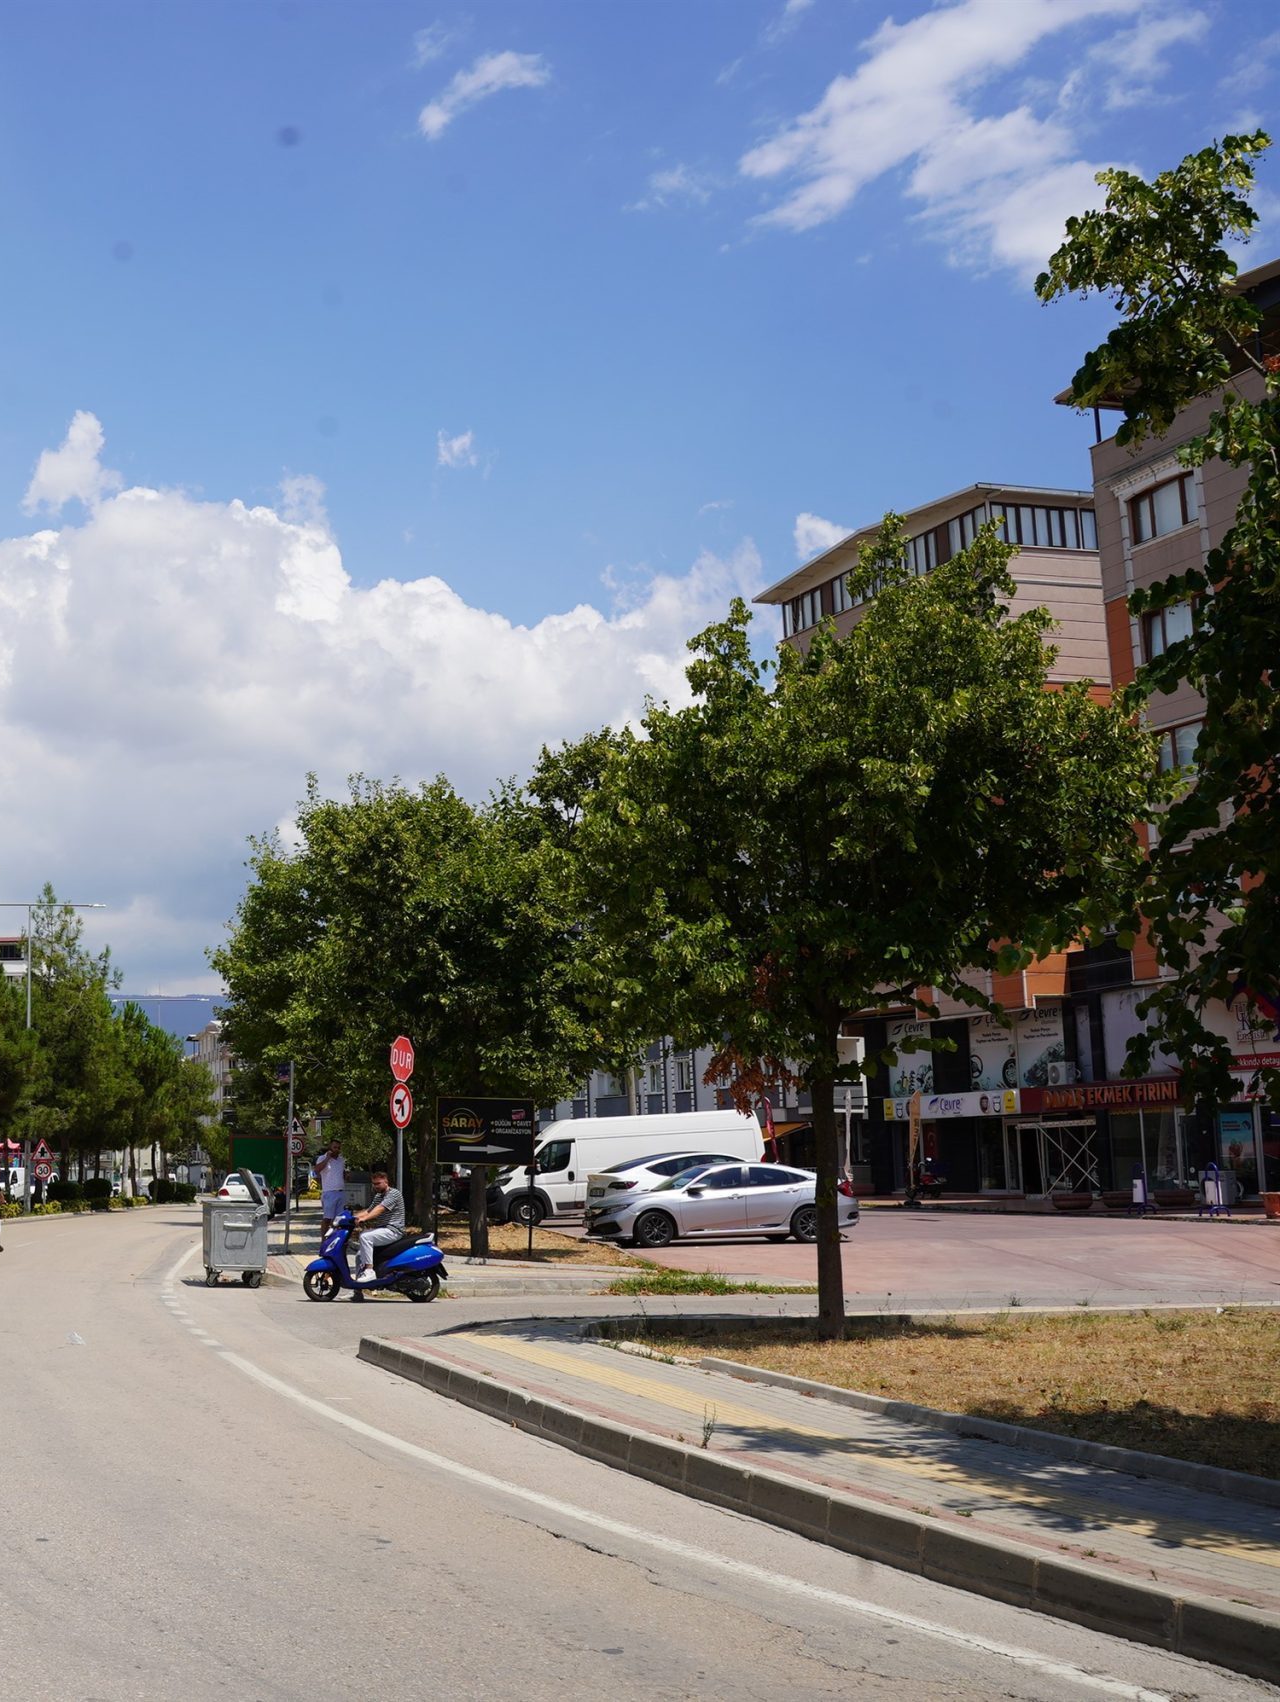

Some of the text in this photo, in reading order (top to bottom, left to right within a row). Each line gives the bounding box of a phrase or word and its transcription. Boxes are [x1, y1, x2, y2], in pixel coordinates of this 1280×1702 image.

[393, 1049, 411, 1070] DUR
[1087, 1085, 1131, 1104] EKMEK
[1135, 1081, 1178, 1102] FIRINI
[940, 1098, 960, 1114] Çevre
[442, 1118, 484, 1128] SARAY
[291, 1142, 300, 1150] 30
[38, 1166, 48, 1175] 30
